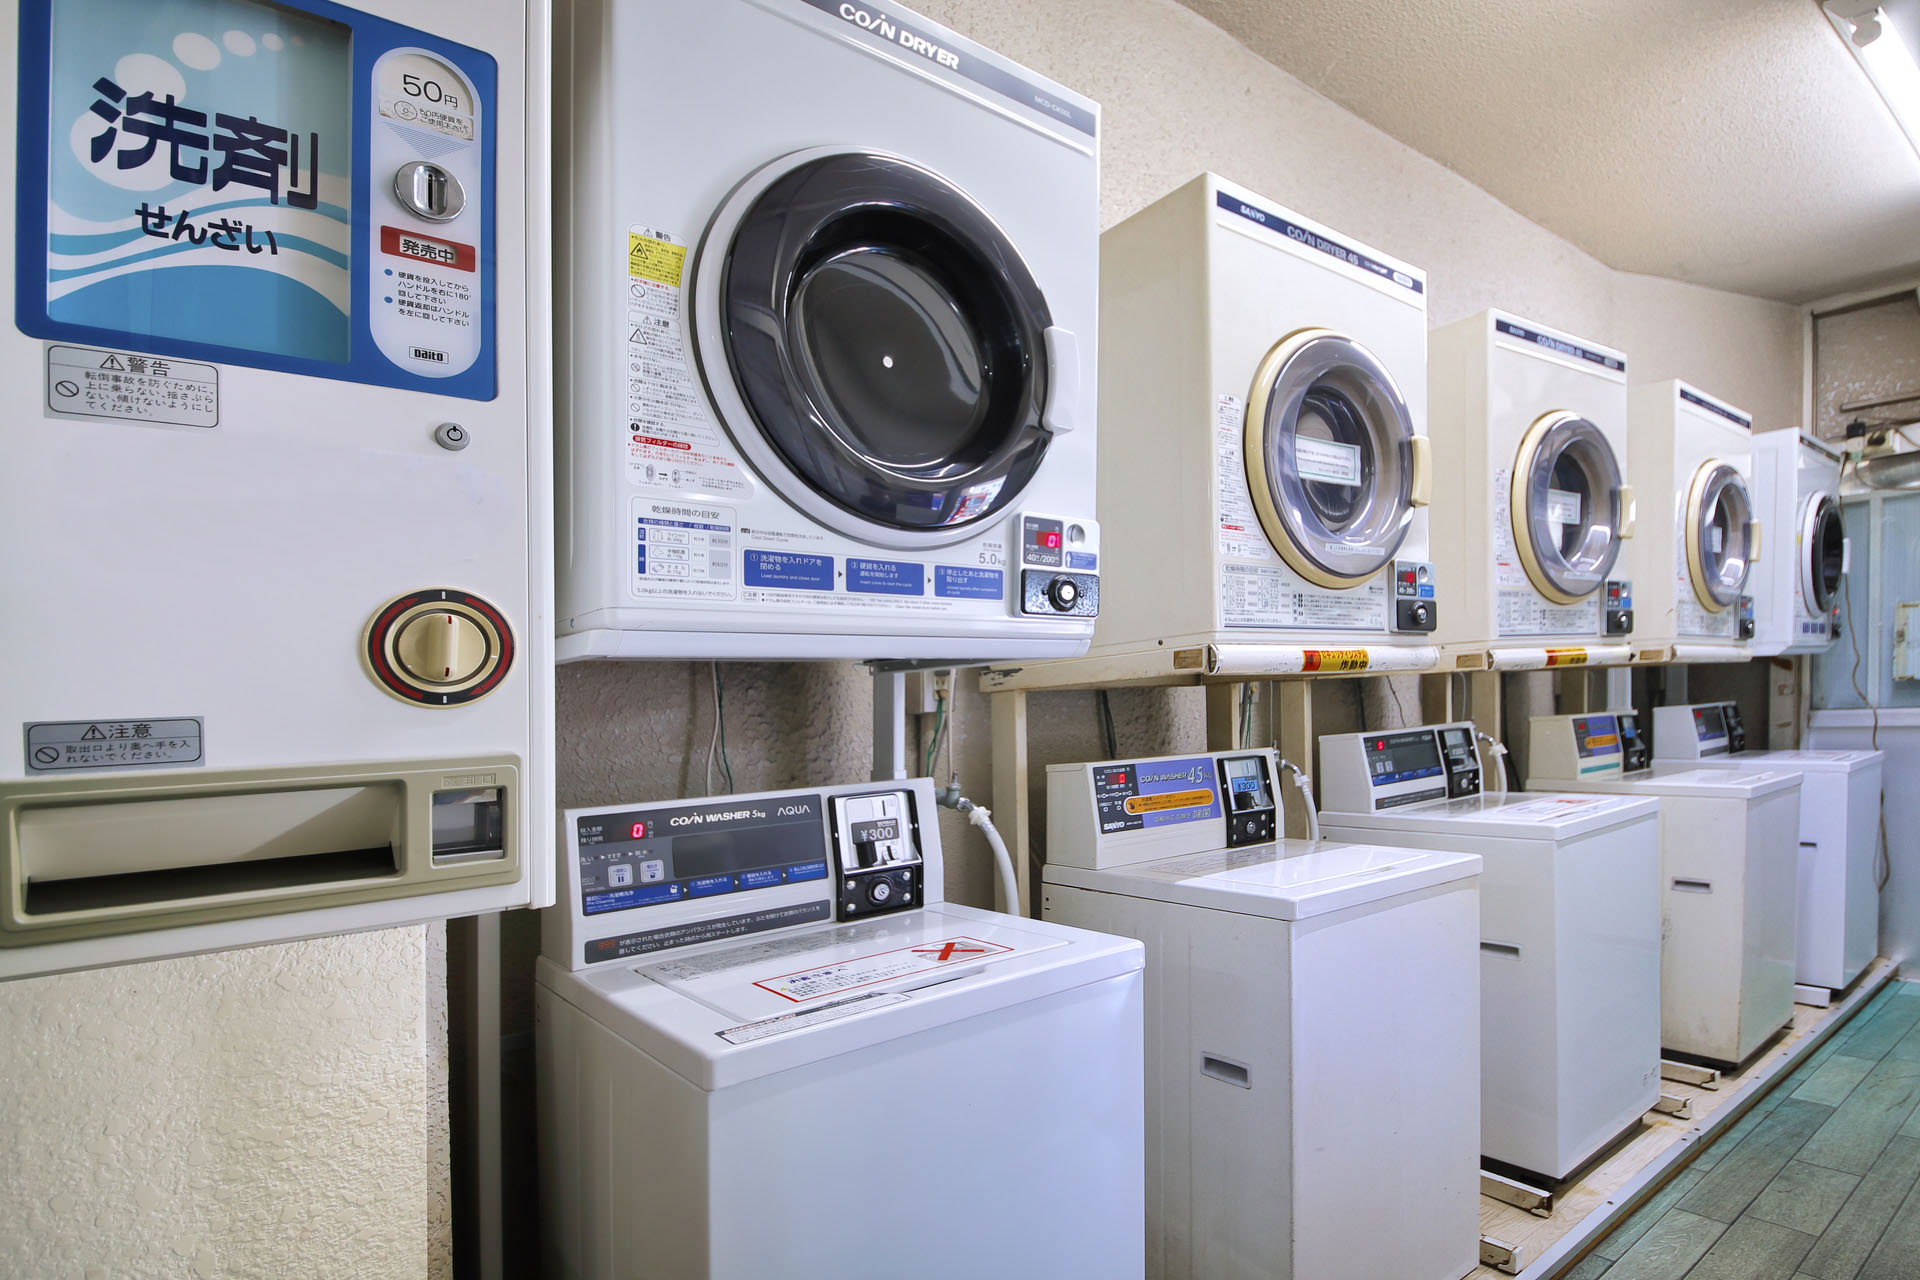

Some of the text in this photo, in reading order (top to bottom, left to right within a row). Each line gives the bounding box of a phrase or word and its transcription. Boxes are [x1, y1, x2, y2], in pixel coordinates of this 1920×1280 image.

[839, 3, 959, 70] COIN DRYER
[403, 74, 458, 108] 50円
[90, 77, 318, 210] 洗剤
[135, 202, 279, 255] せんざい
[1240, 204, 1265, 223] SANYO
[1317, 238, 1347, 262] DRYER
[402, 239, 454, 262] 発売中
[398, 290, 446, 304] 回して下さい
[398, 308, 469, 327] を左に回して下さい
[127, 356, 170, 376] 警告
[652, 505, 720, 519] 乾燥時間の目安
[1340, 659, 1367, 670] 作動中
[108, 723, 152, 739] 注意
[670, 810, 766, 826] COIN WASHER 5kg
[777, 805, 810, 816] AQUA
[632, 823, 644, 838] 0
[1103, 821, 1125, 830] SANYO
[860, 827, 893, 841] ¥300
